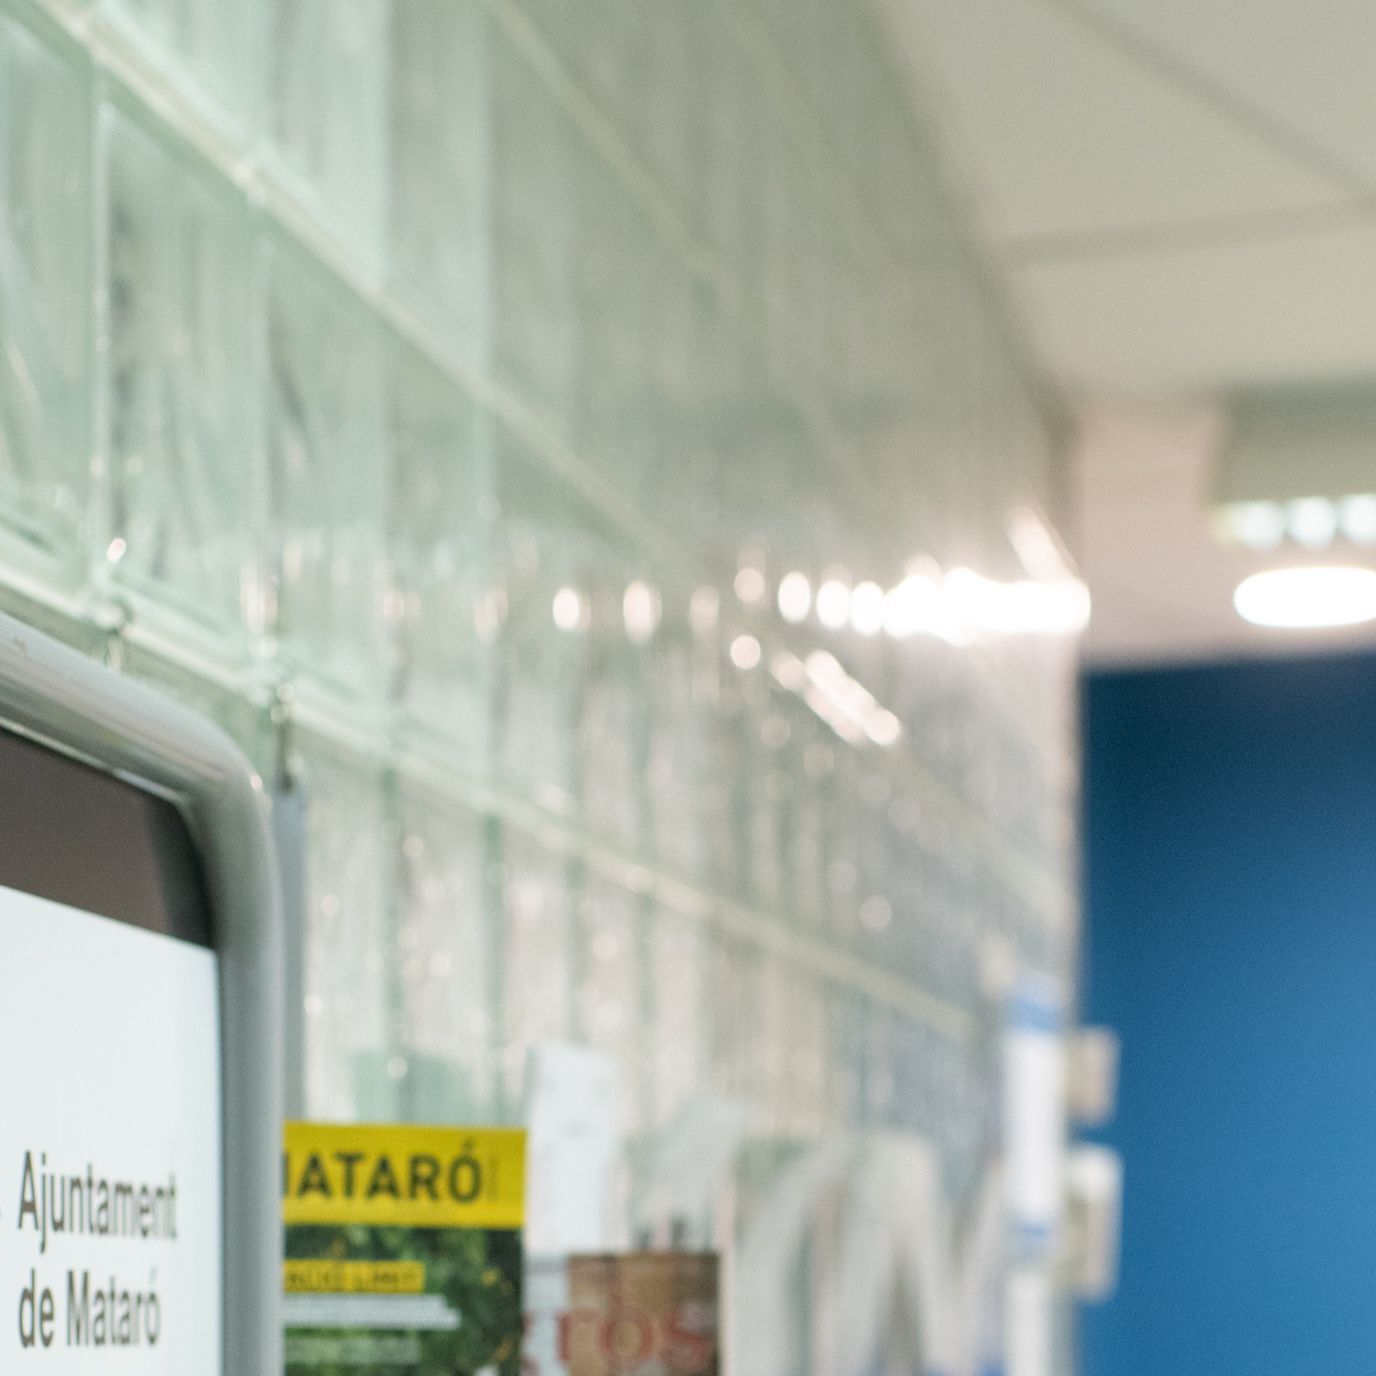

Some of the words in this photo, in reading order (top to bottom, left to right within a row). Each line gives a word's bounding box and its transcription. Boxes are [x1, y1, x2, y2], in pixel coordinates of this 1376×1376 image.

[17, 1150, 178, 1255] Ajuntament
[283, 1139, 482, 1204] ATARÓ
[19, 1270, 55, 1349] de
[66, 1267, 161, 1348] Mataró
